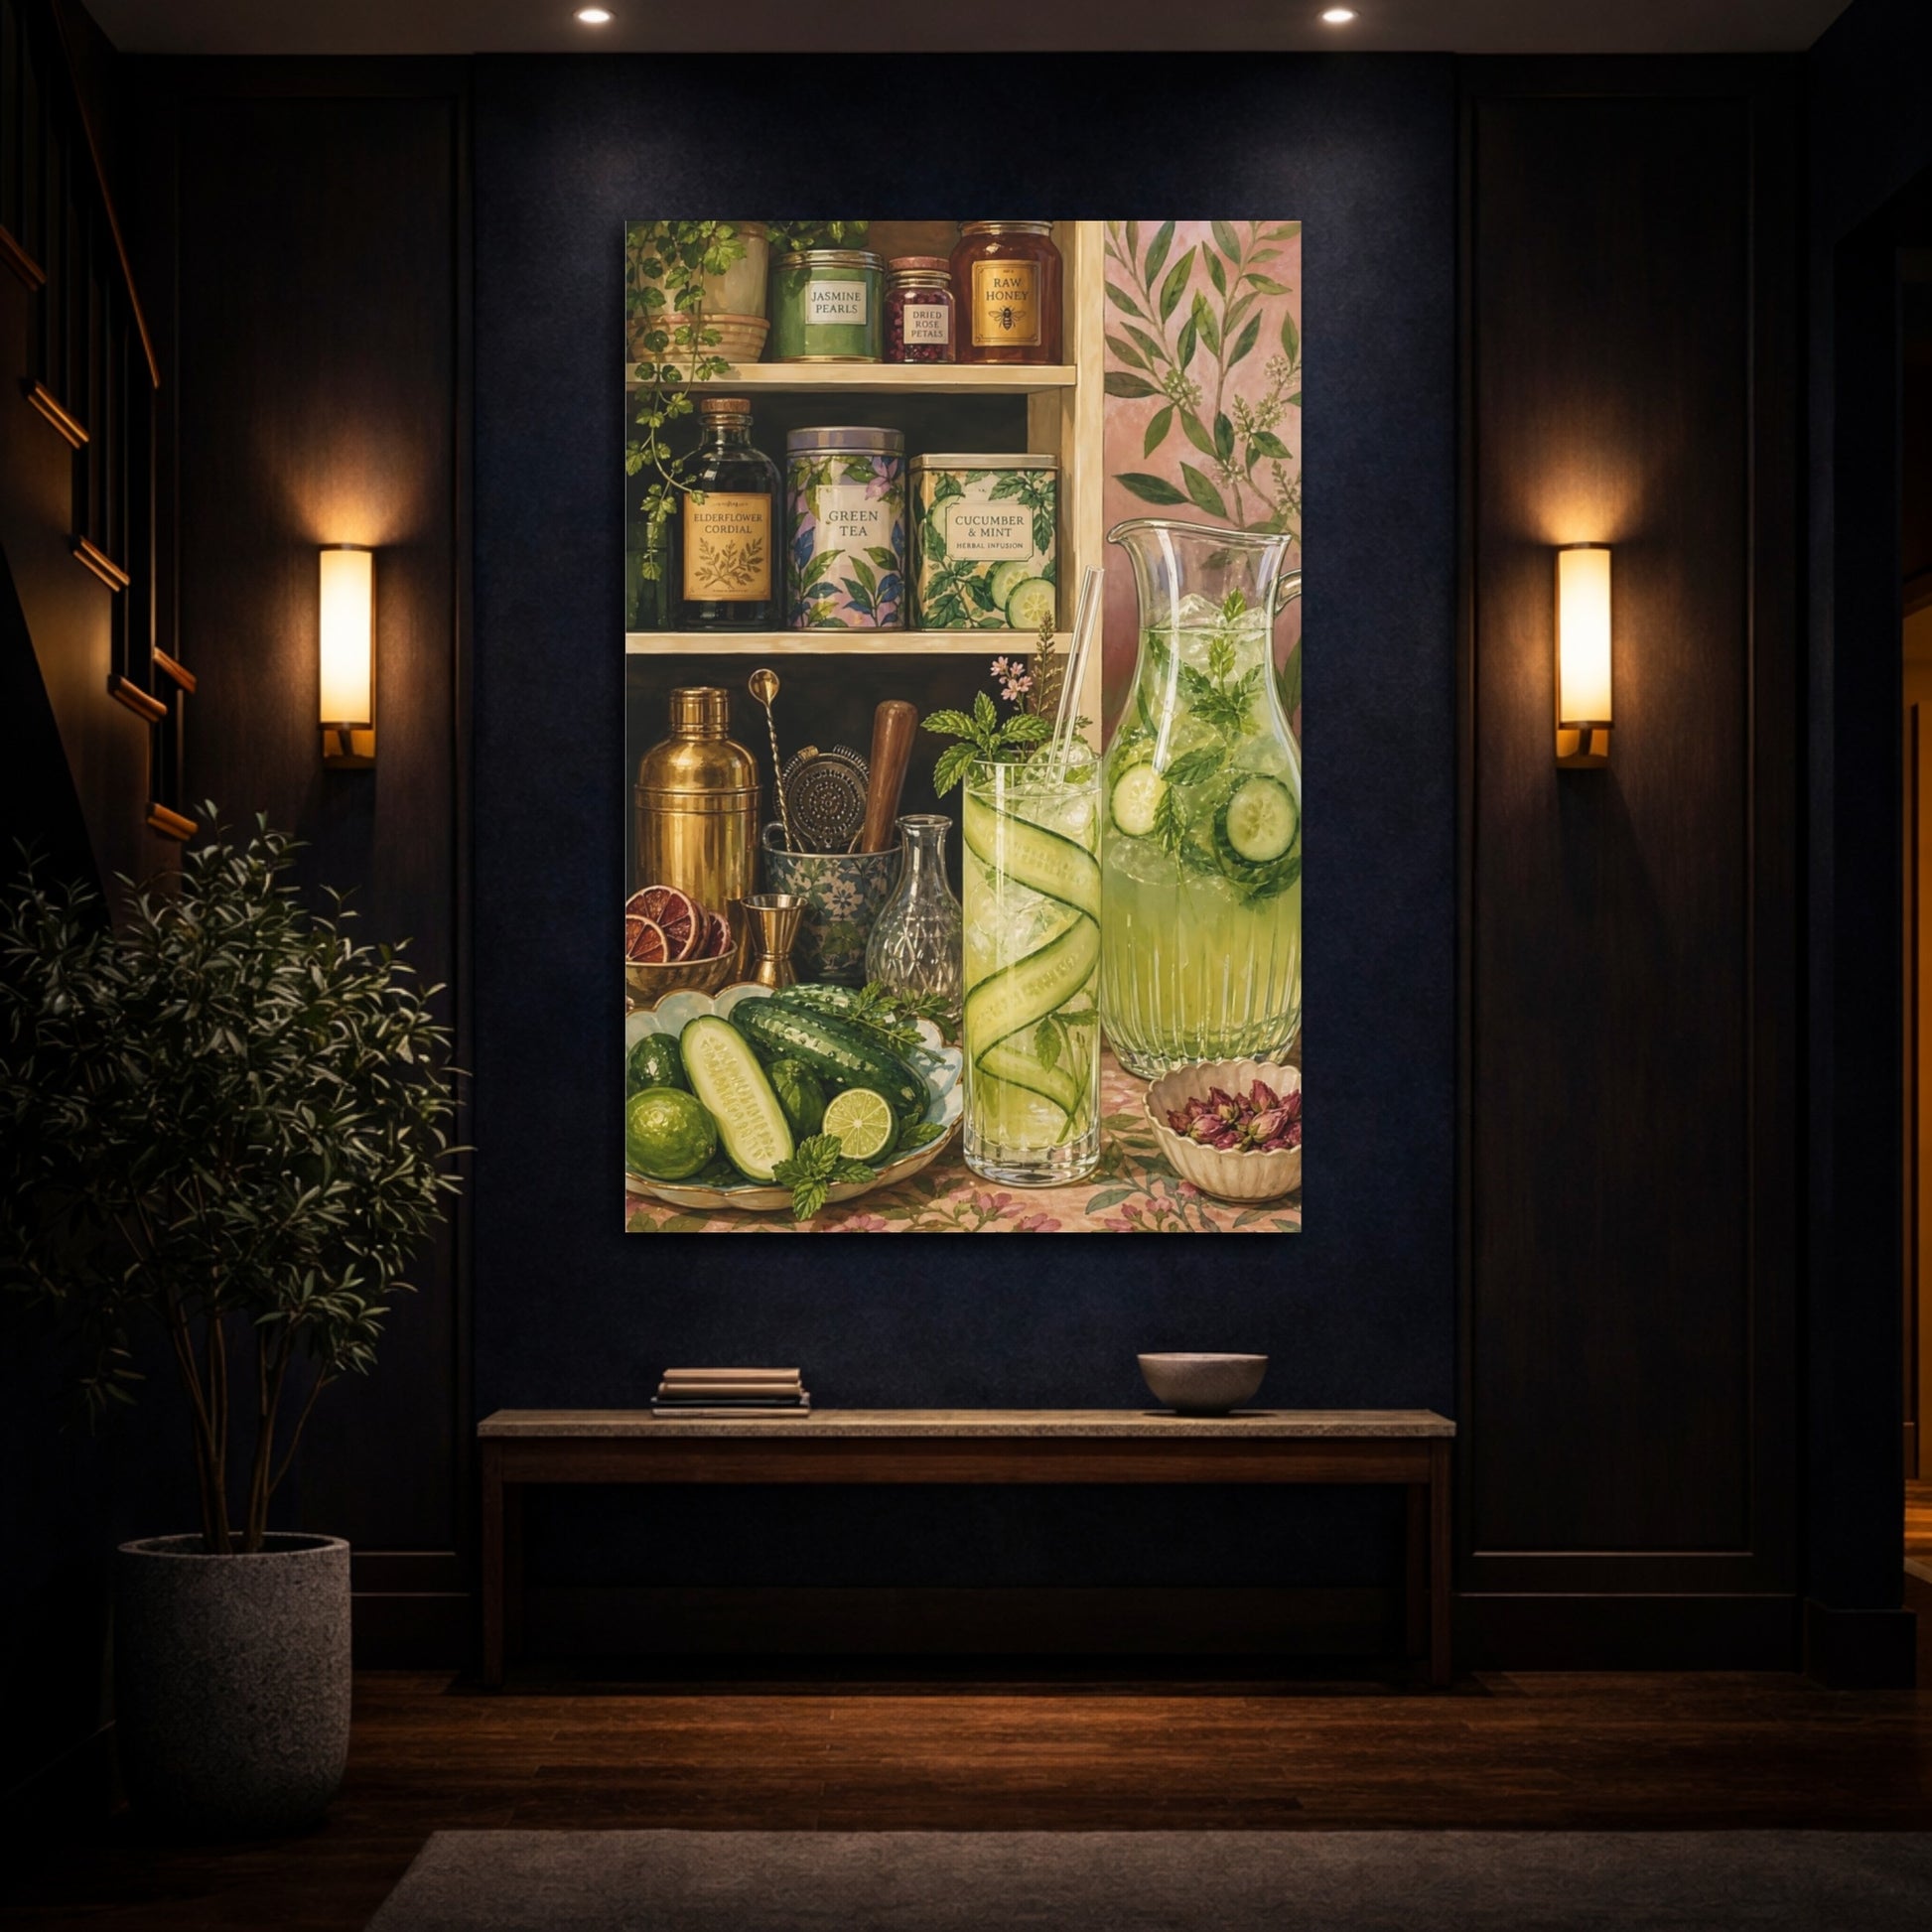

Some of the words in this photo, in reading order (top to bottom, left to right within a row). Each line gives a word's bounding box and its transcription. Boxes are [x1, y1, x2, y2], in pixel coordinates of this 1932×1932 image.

[994, 278, 1022, 288] RAW
[811, 291, 861, 302] JASMINE
[986, 291, 1029, 301] HONEY
[816, 304, 858, 314] PEARLS
[694, 513, 762, 523] ELDERFLOWER
[829, 510, 878, 522] GREEN
[955, 515, 1025, 526] CUCUMBER
[705, 524, 753, 534] CORDIAL
[840, 526, 868, 537] TEA
[968, 528, 977, 537] &
[979, 527, 1013, 537] MINT
